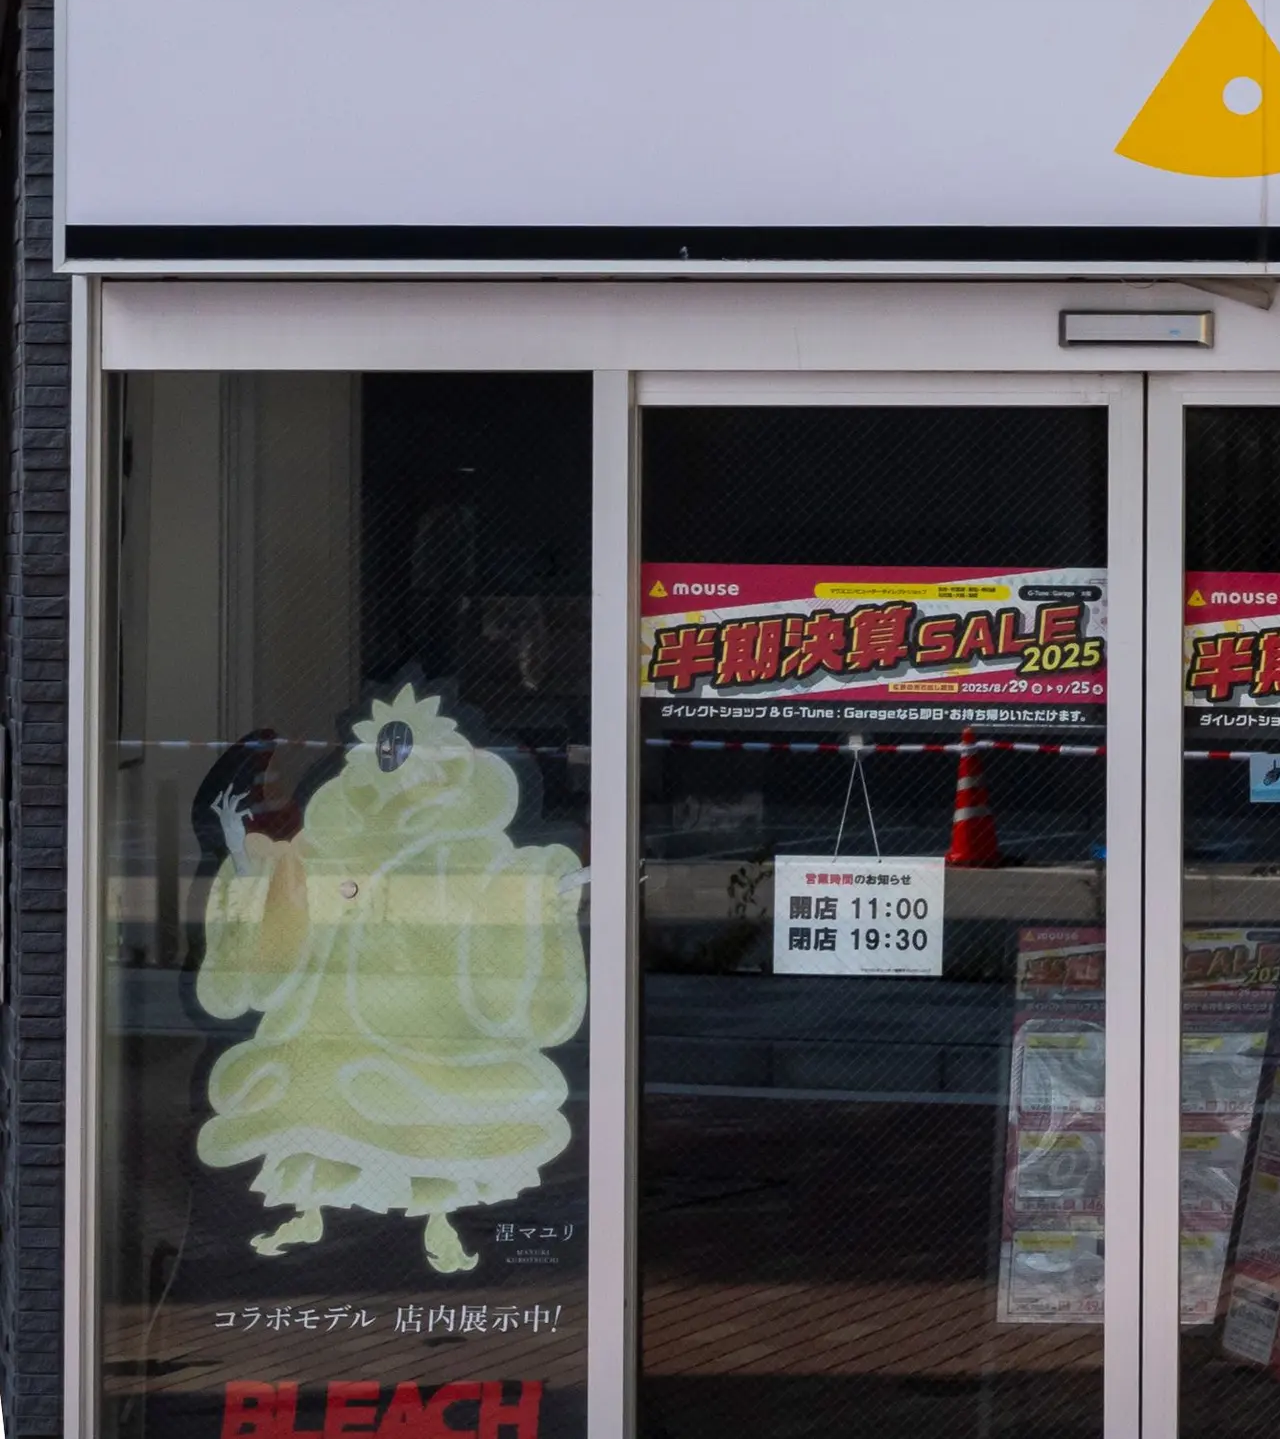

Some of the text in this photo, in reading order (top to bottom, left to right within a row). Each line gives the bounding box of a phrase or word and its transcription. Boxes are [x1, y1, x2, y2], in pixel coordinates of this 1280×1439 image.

[673, 581, 740, 597] mouse
[1210, 589, 1279, 606] mouse
[1022, 642, 1102, 674] 2025
[961, 679, 1028, 695] 2025/8/29
[789, 895, 929, 920] 開店 11:00
[788, 926, 928, 952] 閉店 19:30
[495, 1223, 575, 1243] 涅マユリ
[213, 1304, 563, 1334] コラボモデル 店内展示中!
[220, 1380, 544, 1439] BLEACH
